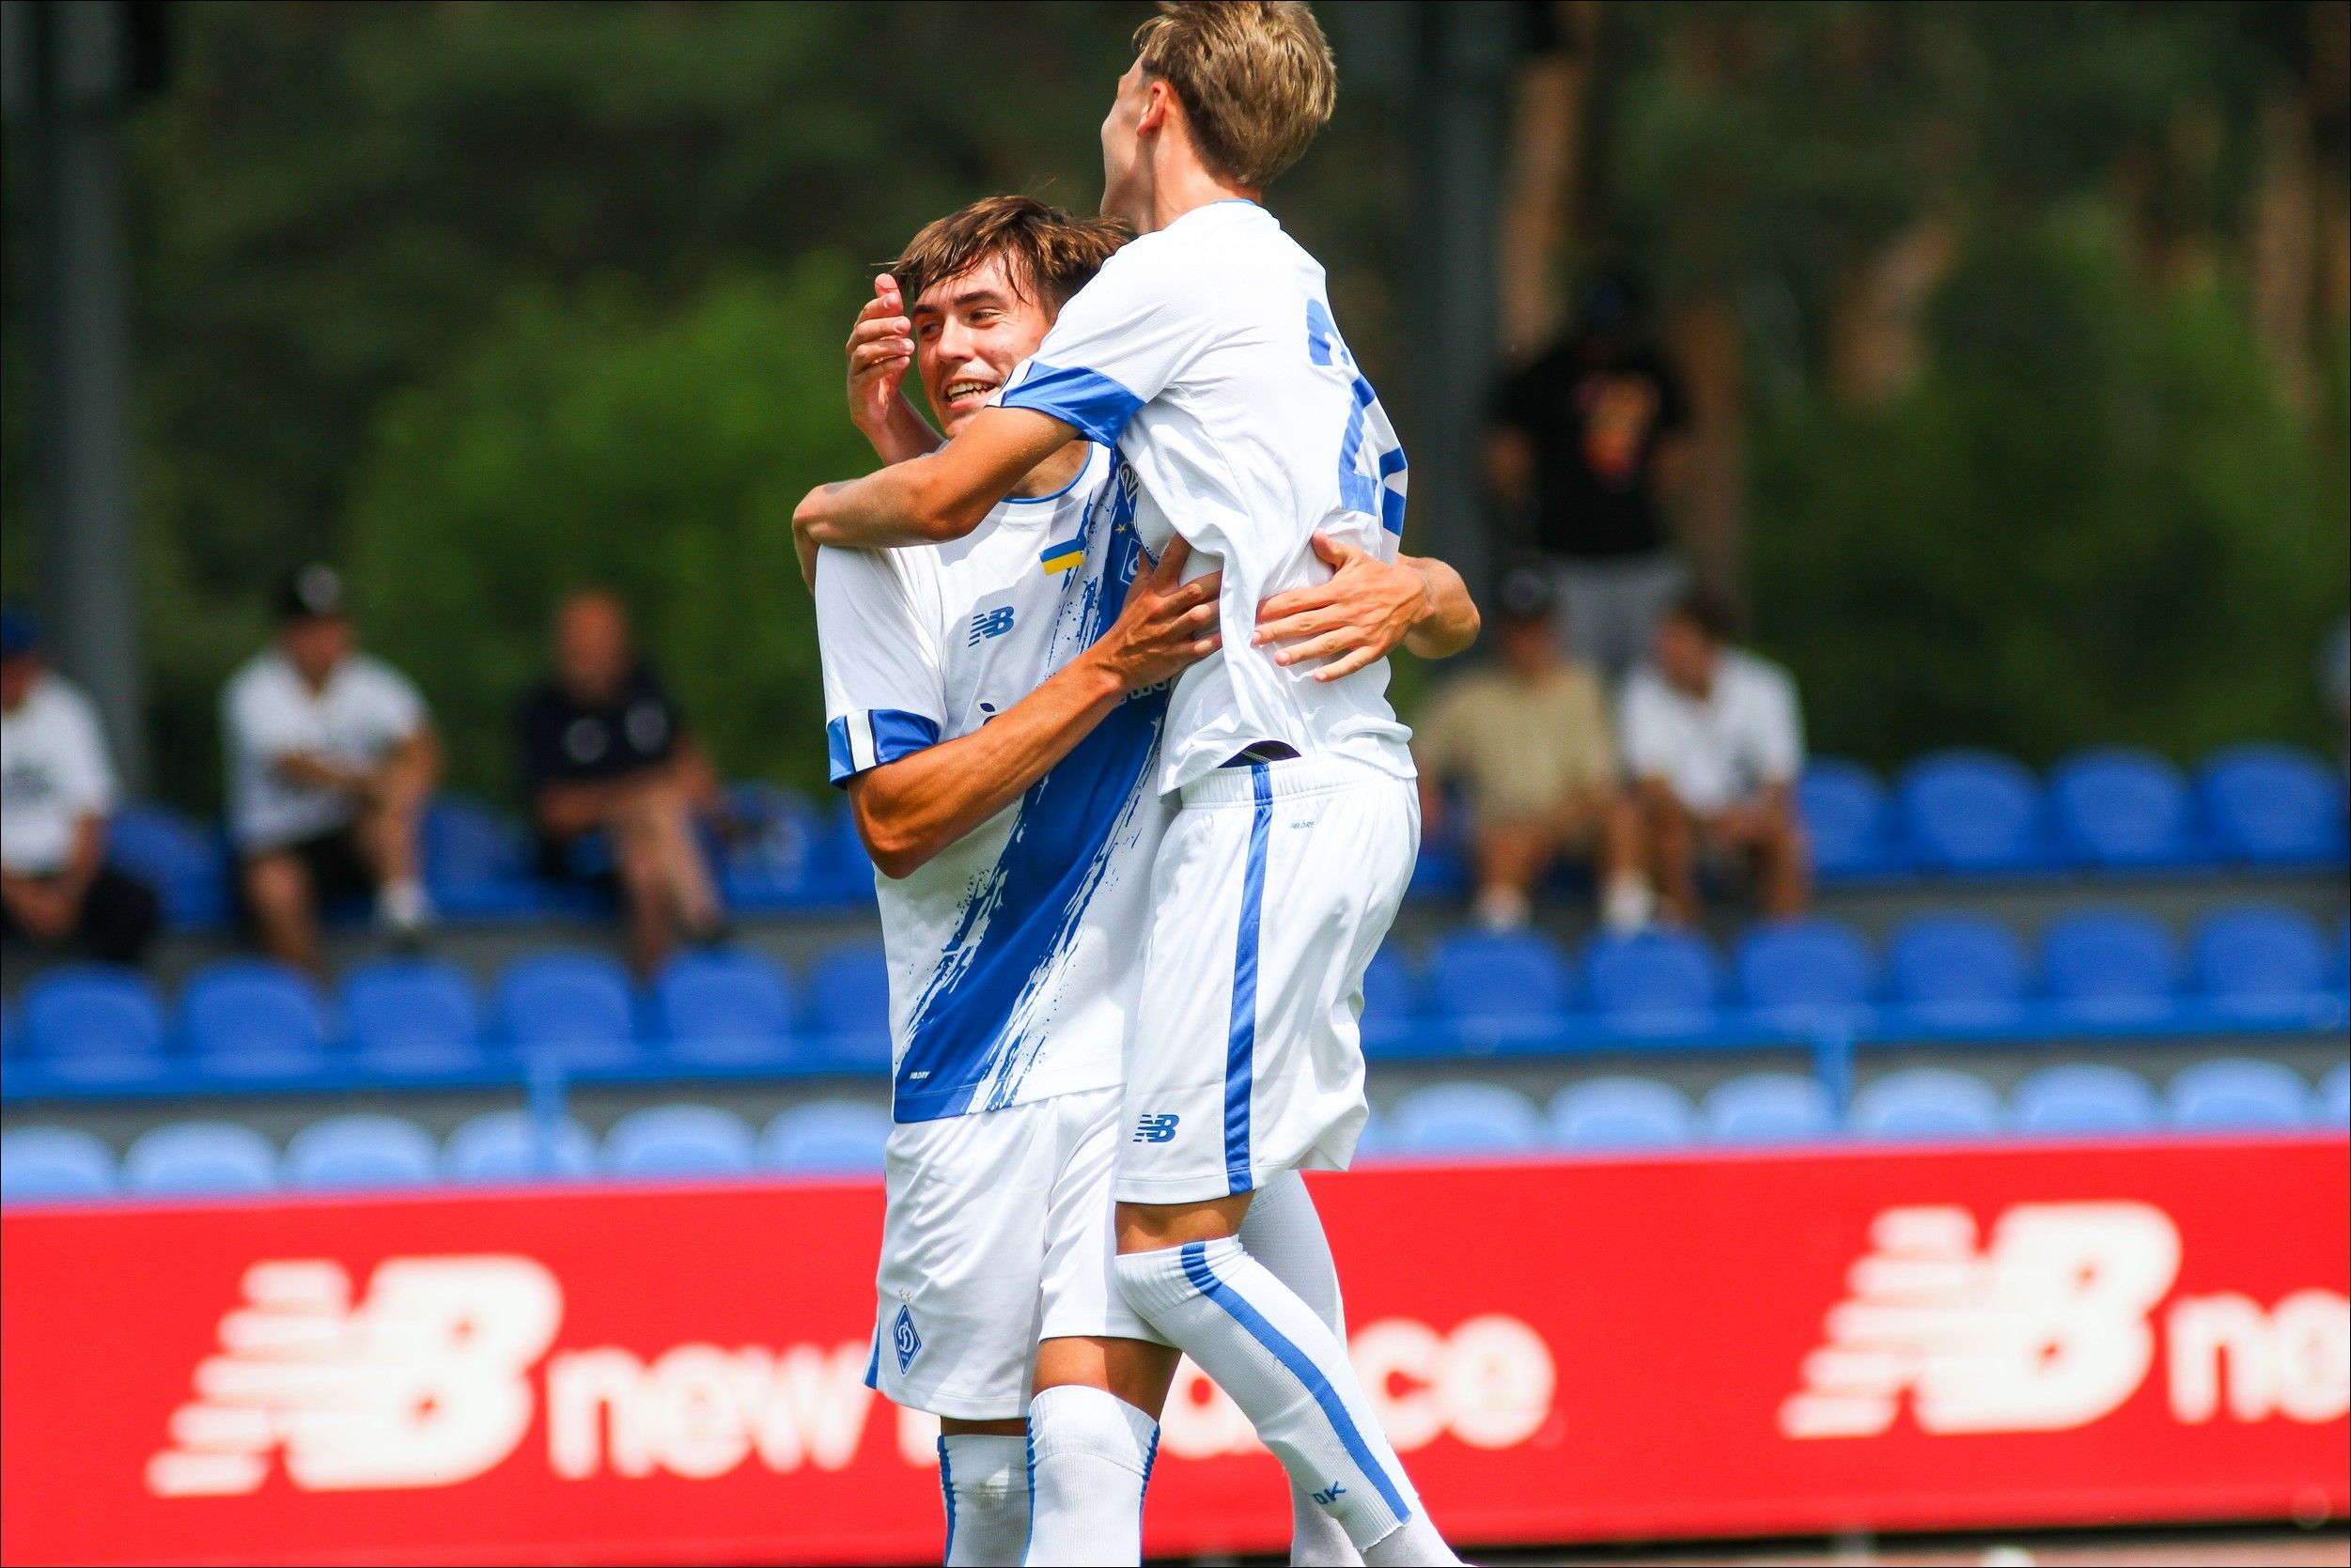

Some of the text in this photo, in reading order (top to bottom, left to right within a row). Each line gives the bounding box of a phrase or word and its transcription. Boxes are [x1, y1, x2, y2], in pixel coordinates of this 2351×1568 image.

[968, 606, 1015, 647] NB
[1132, 1113, 1180, 1143] NB
[147, 1254, 563, 1497] NB
[543, 1342, 876, 1480] new
[1780, 1202, 2181, 1438] NB
